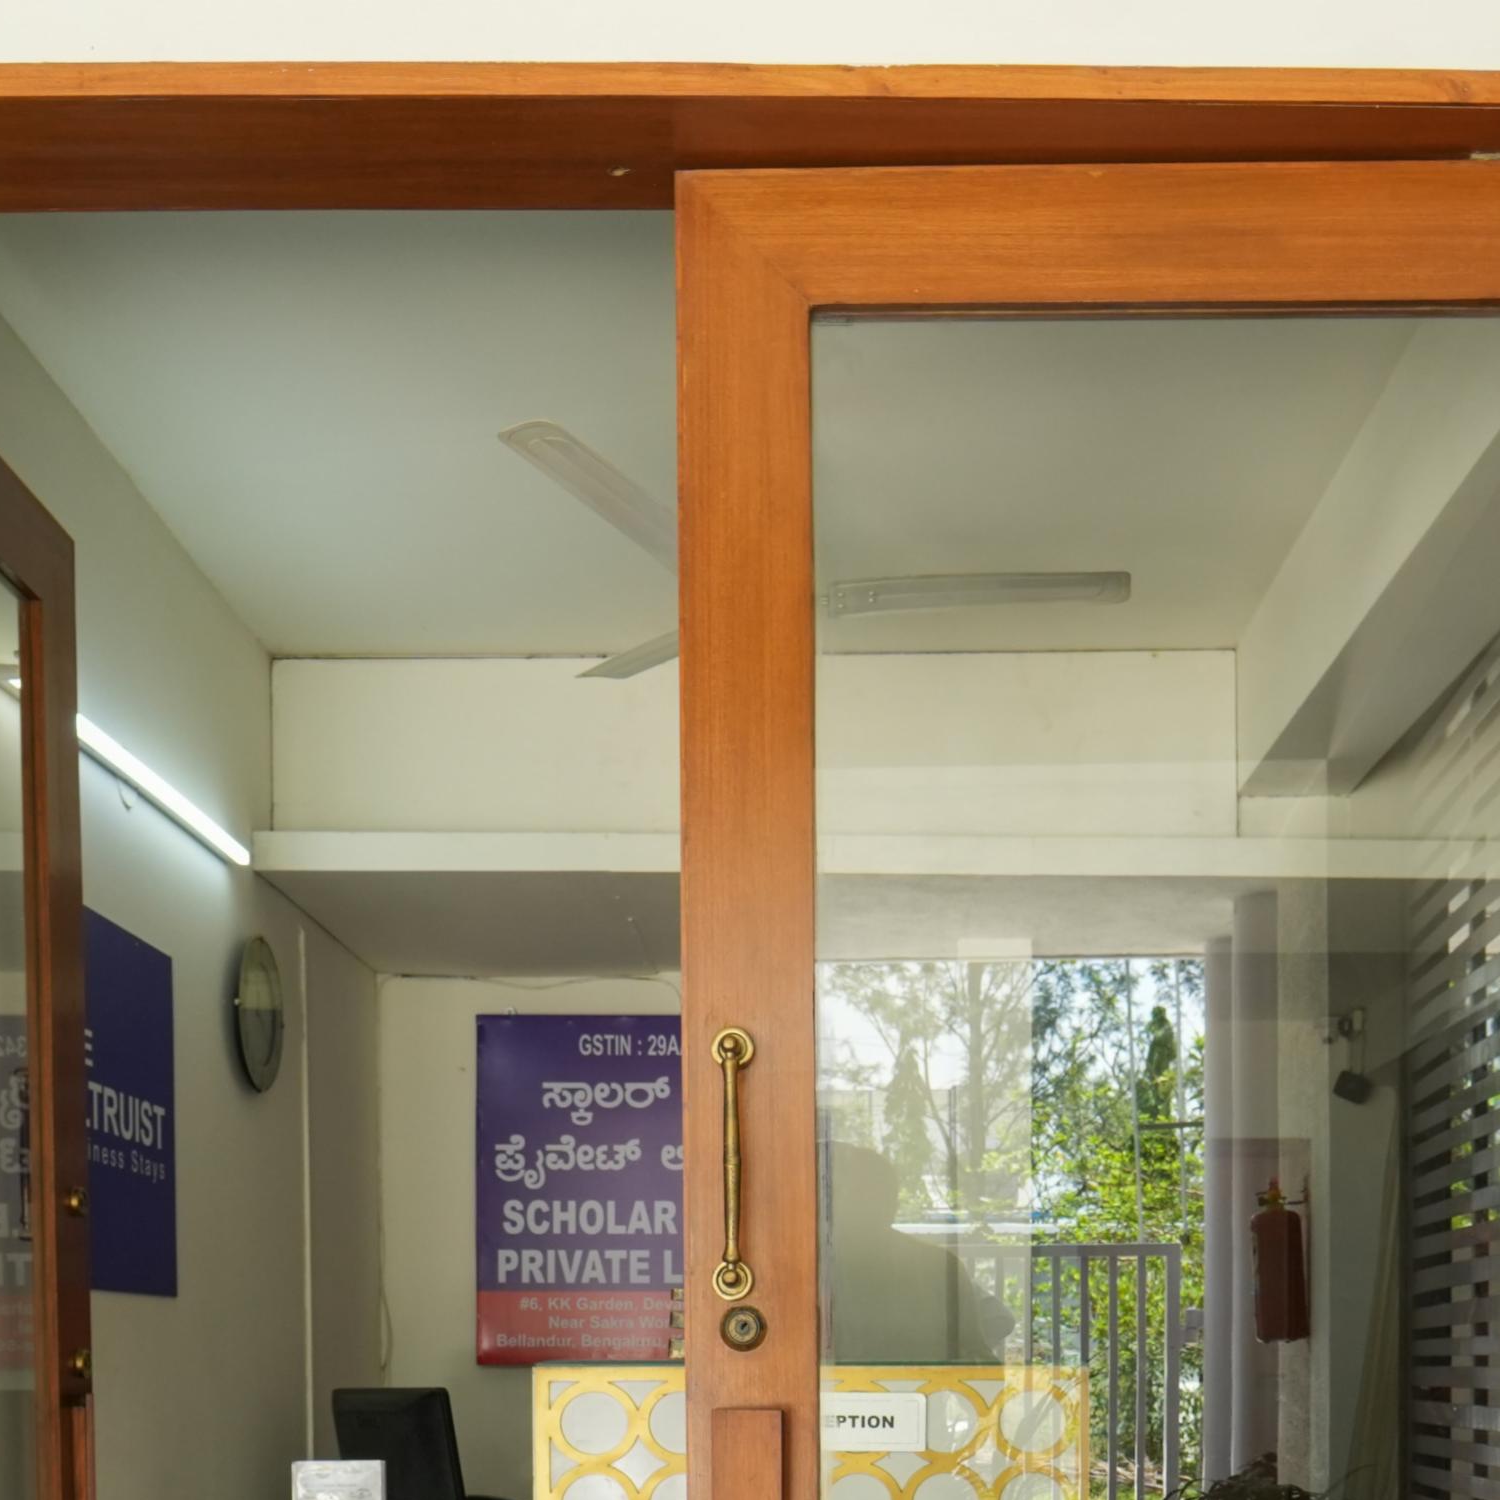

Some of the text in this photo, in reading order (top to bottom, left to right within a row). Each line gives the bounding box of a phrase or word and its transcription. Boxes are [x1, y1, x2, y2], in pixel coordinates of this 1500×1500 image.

[579, 1033, 632, 1056] GSTIN
[647, 1033, 682, 1057] 29A
[85, 1080, 166, 1150] TRUIST
[130, 1149, 166, 1184] Stays
[502, 1199, 678, 1236] SCHOLAR
[497, 1249, 651, 1284] PRIVATE
[548, 1297, 571, 1311] KK
[548, 1315, 585, 1329] Near
[589, 1315, 634, 1329] Sakra
